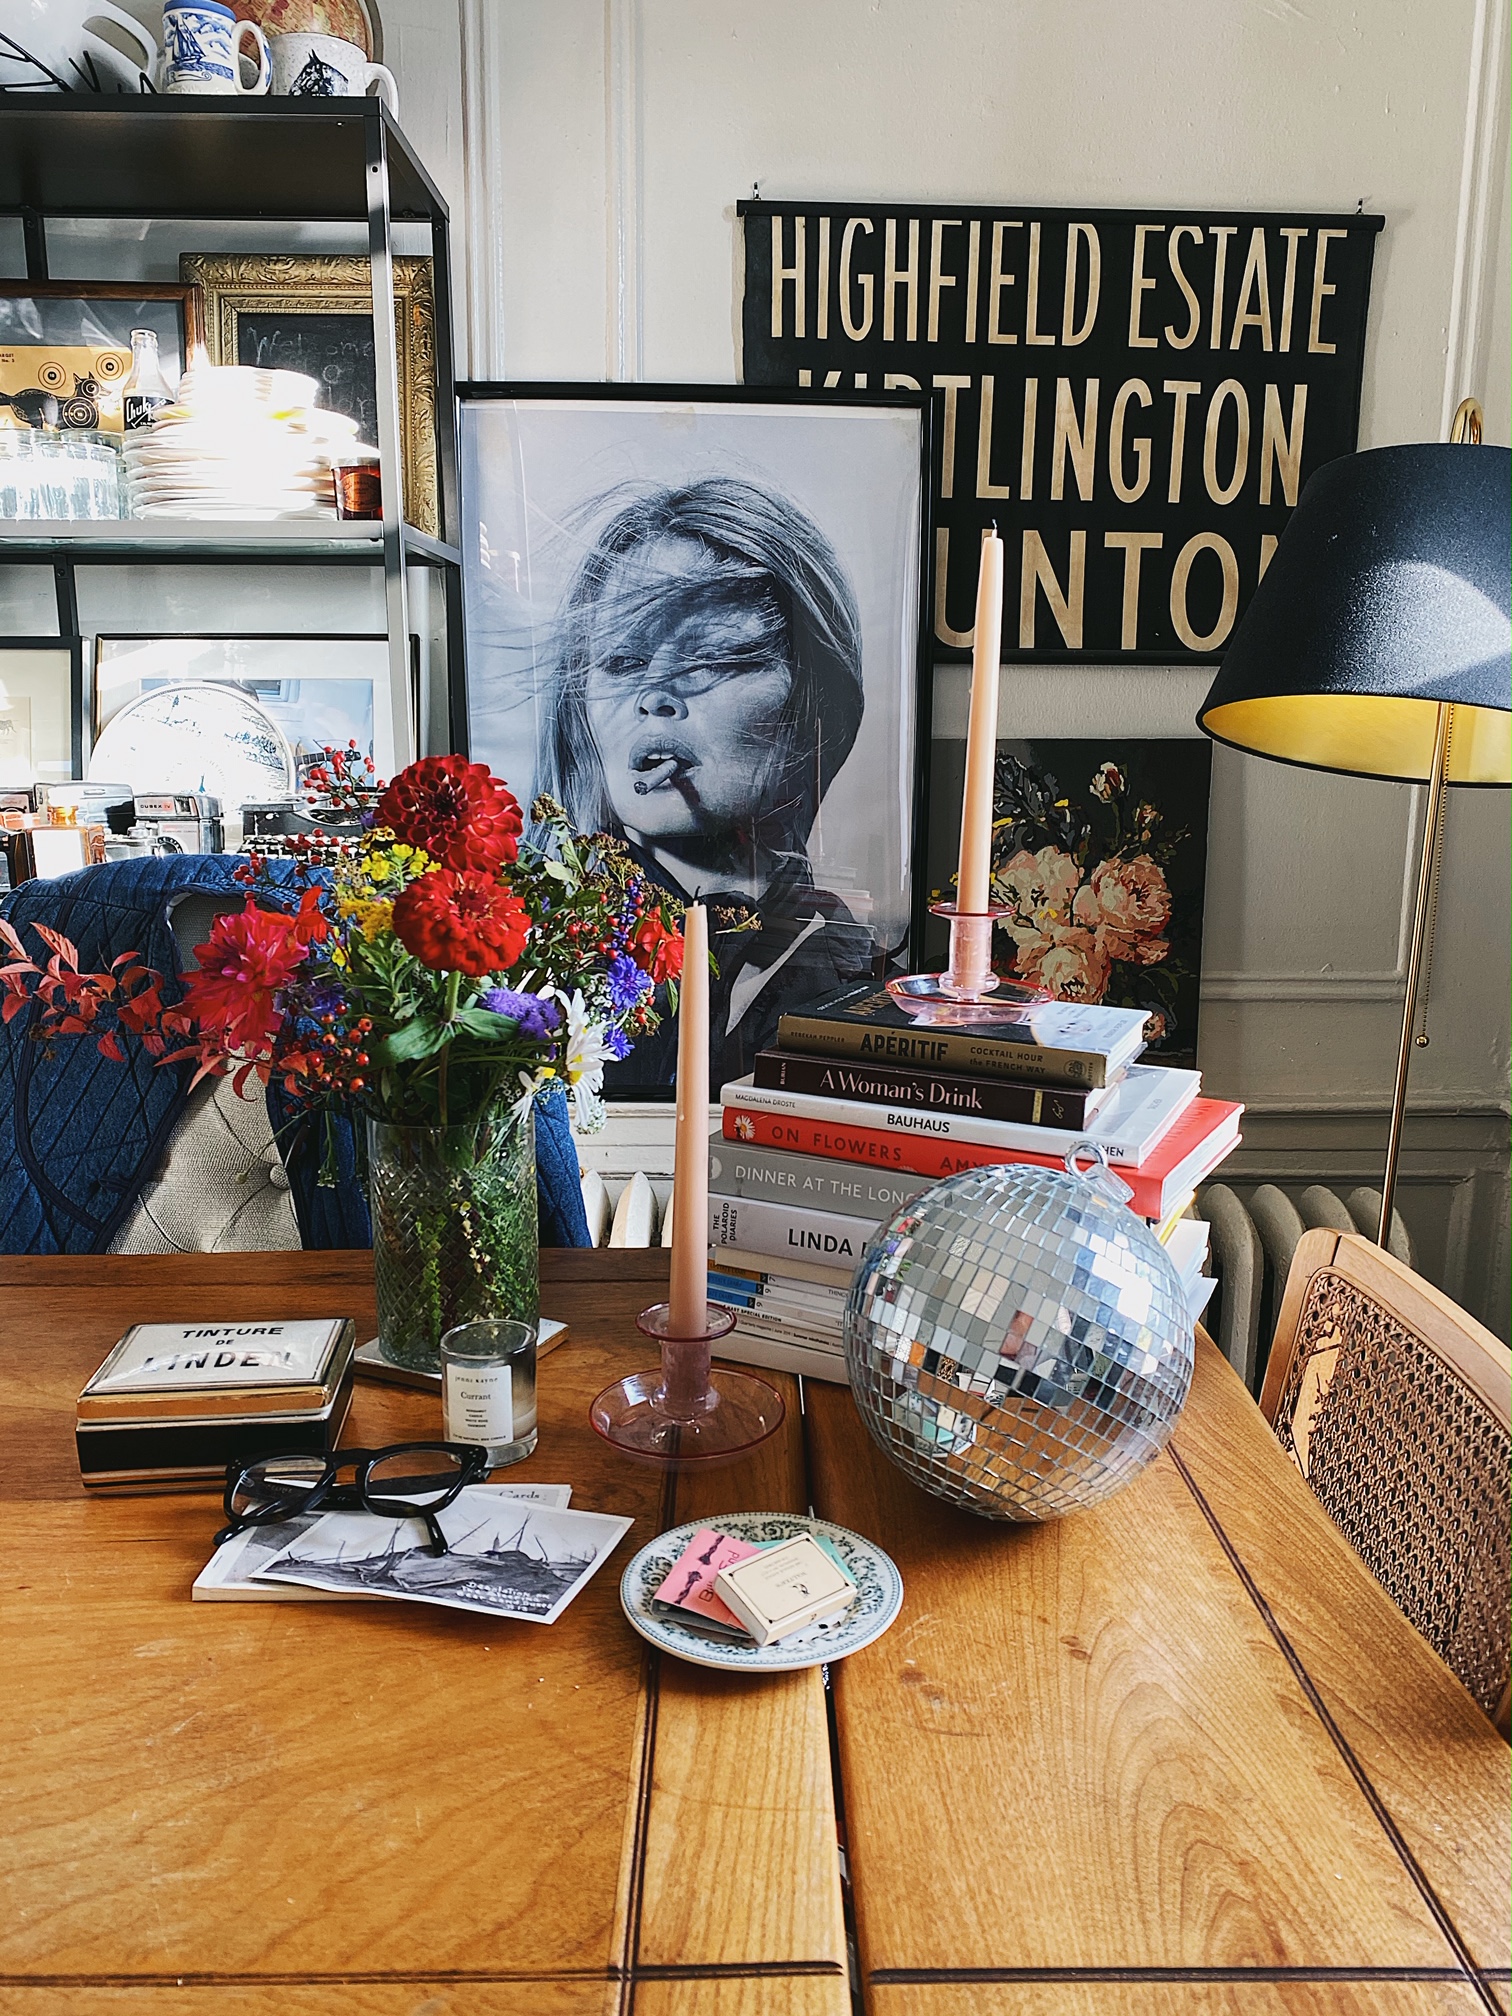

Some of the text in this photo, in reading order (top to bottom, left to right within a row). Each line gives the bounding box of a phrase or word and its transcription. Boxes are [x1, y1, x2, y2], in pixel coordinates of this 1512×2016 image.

[771, 215, 1348, 354] HIGHFIELD ESTATE
[799, 369, 1308, 507] TLINGTON
[934, 527, 1280, 652] UNTO
[790, 1031, 845, 1043] REBEKAH PEPPLER
[860, 1031, 949, 1062] APÉRITIF
[969, 1058, 1046, 1075] the FRENCH WAY
[970, 1046, 1044, 1063] COCKTAIL HOUR
[735, 1093, 796, 1109] MAGDALENA DROSTE
[819, 1069, 835, 1090] A
[929, 1082, 983, 1109] Drink
[887, 1113, 950, 1133] BAUHAUS
[771, 1126, 902, 1162] ON FLOWERS
[735, 1165, 797, 1188] DINNER
[802, 1176, 825, 1192] AT
[830, 1180, 863, 1198] THE
[713, 1214, 721, 1230] THE
[720, 1202, 730, 1245] POLAROID
[729, 1209, 738, 1242] DIARIES
[788, 1228, 854, 1257] LINDA
[740, 1309, 760, 1318] SPECIAL
[761, 1313, 782, 1322] EDITION
[182, 1326, 284, 1339] TINTURE
[460, 1391, 491, 1400] Currant
